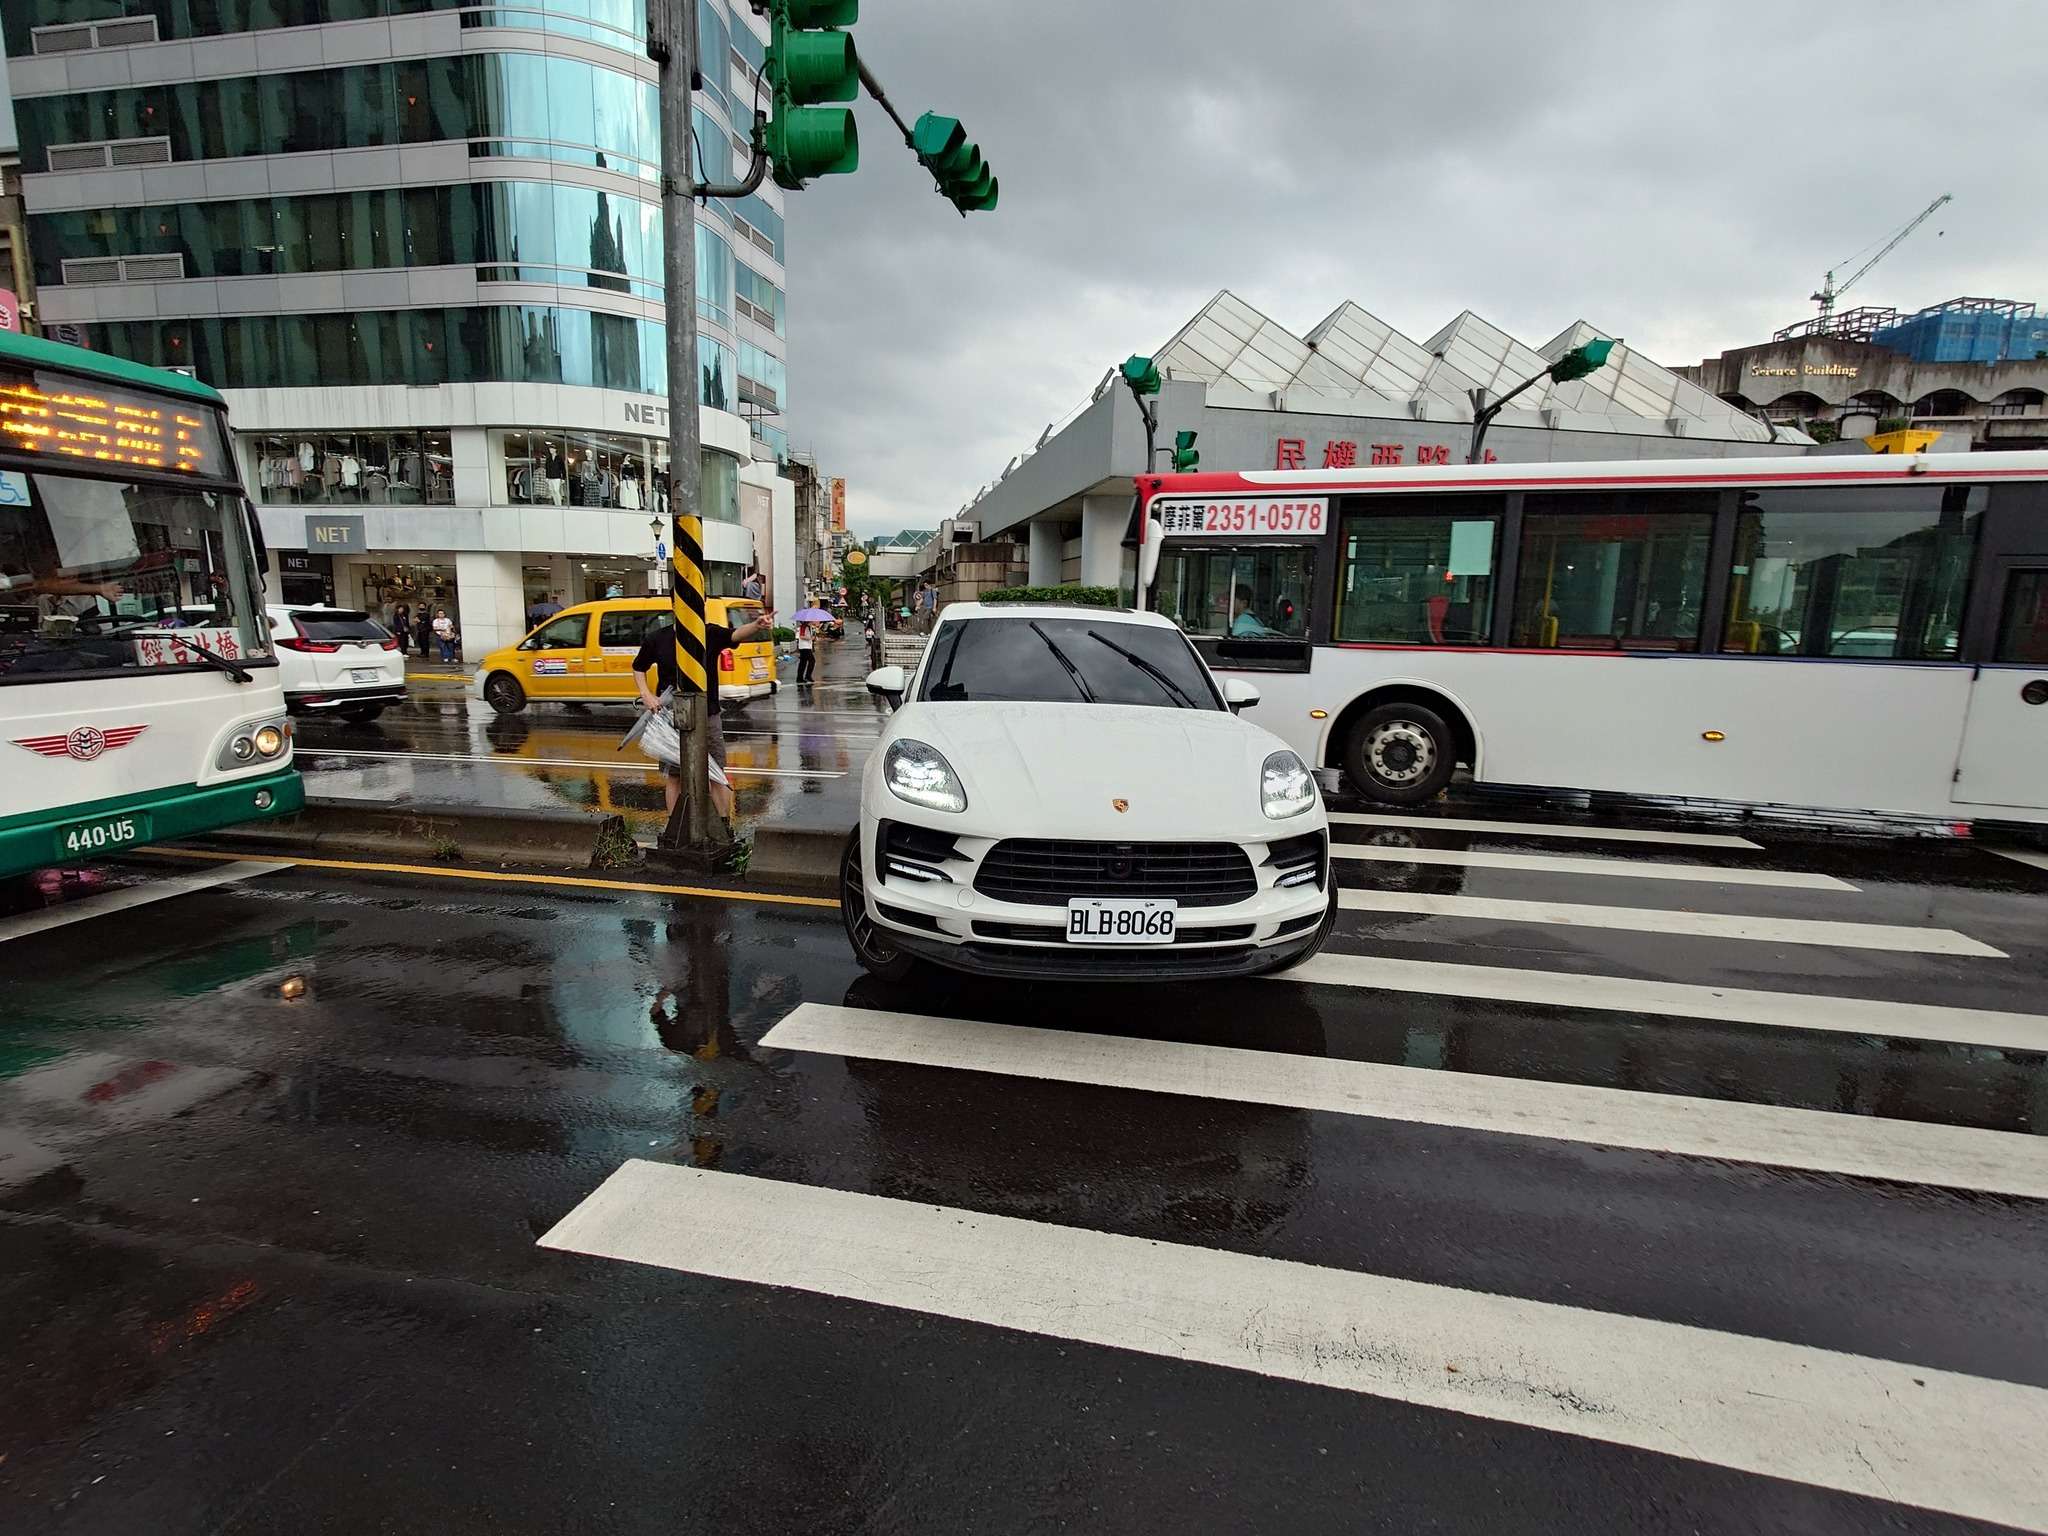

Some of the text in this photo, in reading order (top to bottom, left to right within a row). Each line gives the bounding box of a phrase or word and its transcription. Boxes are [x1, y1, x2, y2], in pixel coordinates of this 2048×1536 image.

[1752, 364, 1858, 379] Science Building
[624, 402, 669, 426] NET
[1206, 503, 1322, 531] 2351-0578
[315, 526, 351, 543] NET
[287, 558, 309, 568] NET
[67, 820, 135, 851] 440-U5
